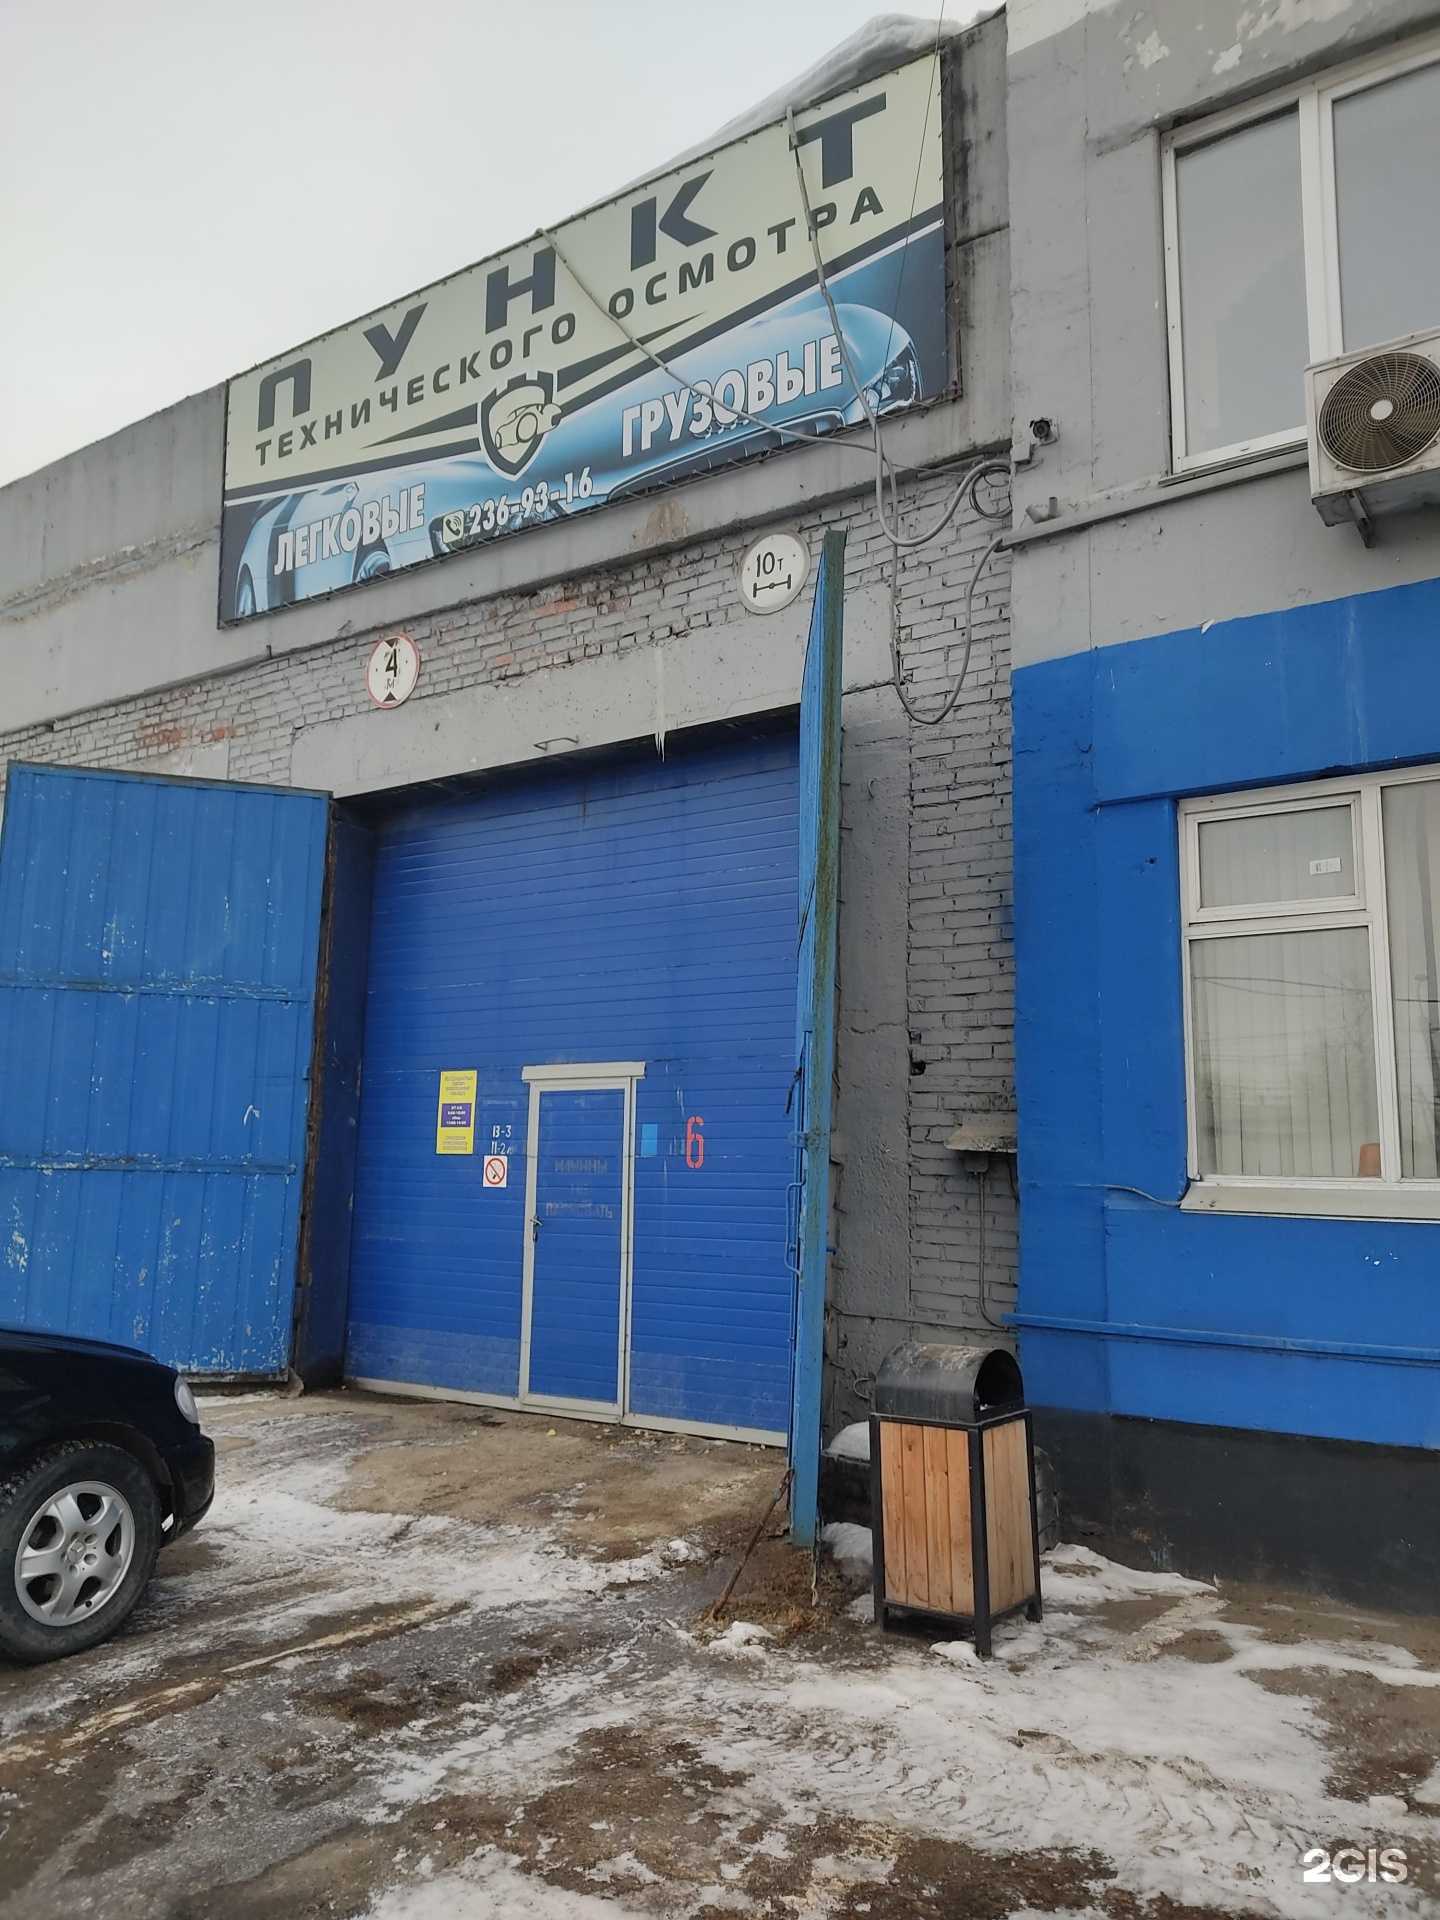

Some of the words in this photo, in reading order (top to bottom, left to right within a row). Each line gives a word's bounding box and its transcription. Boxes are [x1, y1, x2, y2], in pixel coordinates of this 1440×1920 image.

[258, 91, 886, 432] ПУНКТ
[255, 312, 576, 466] ТЕХНИЧЕСКОГО
[608, 186, 884, 320] ОСМОТРА
[622, 332, 843, 457] ГРУЗОВЫЕ
[273, 482, 425, 576] ЛЕГКОВЫЕ
[468, 467, 594, 536] 236-93-16
[385, 648, 398, 678] 4
[686, 1115, 705, 1169] 6
